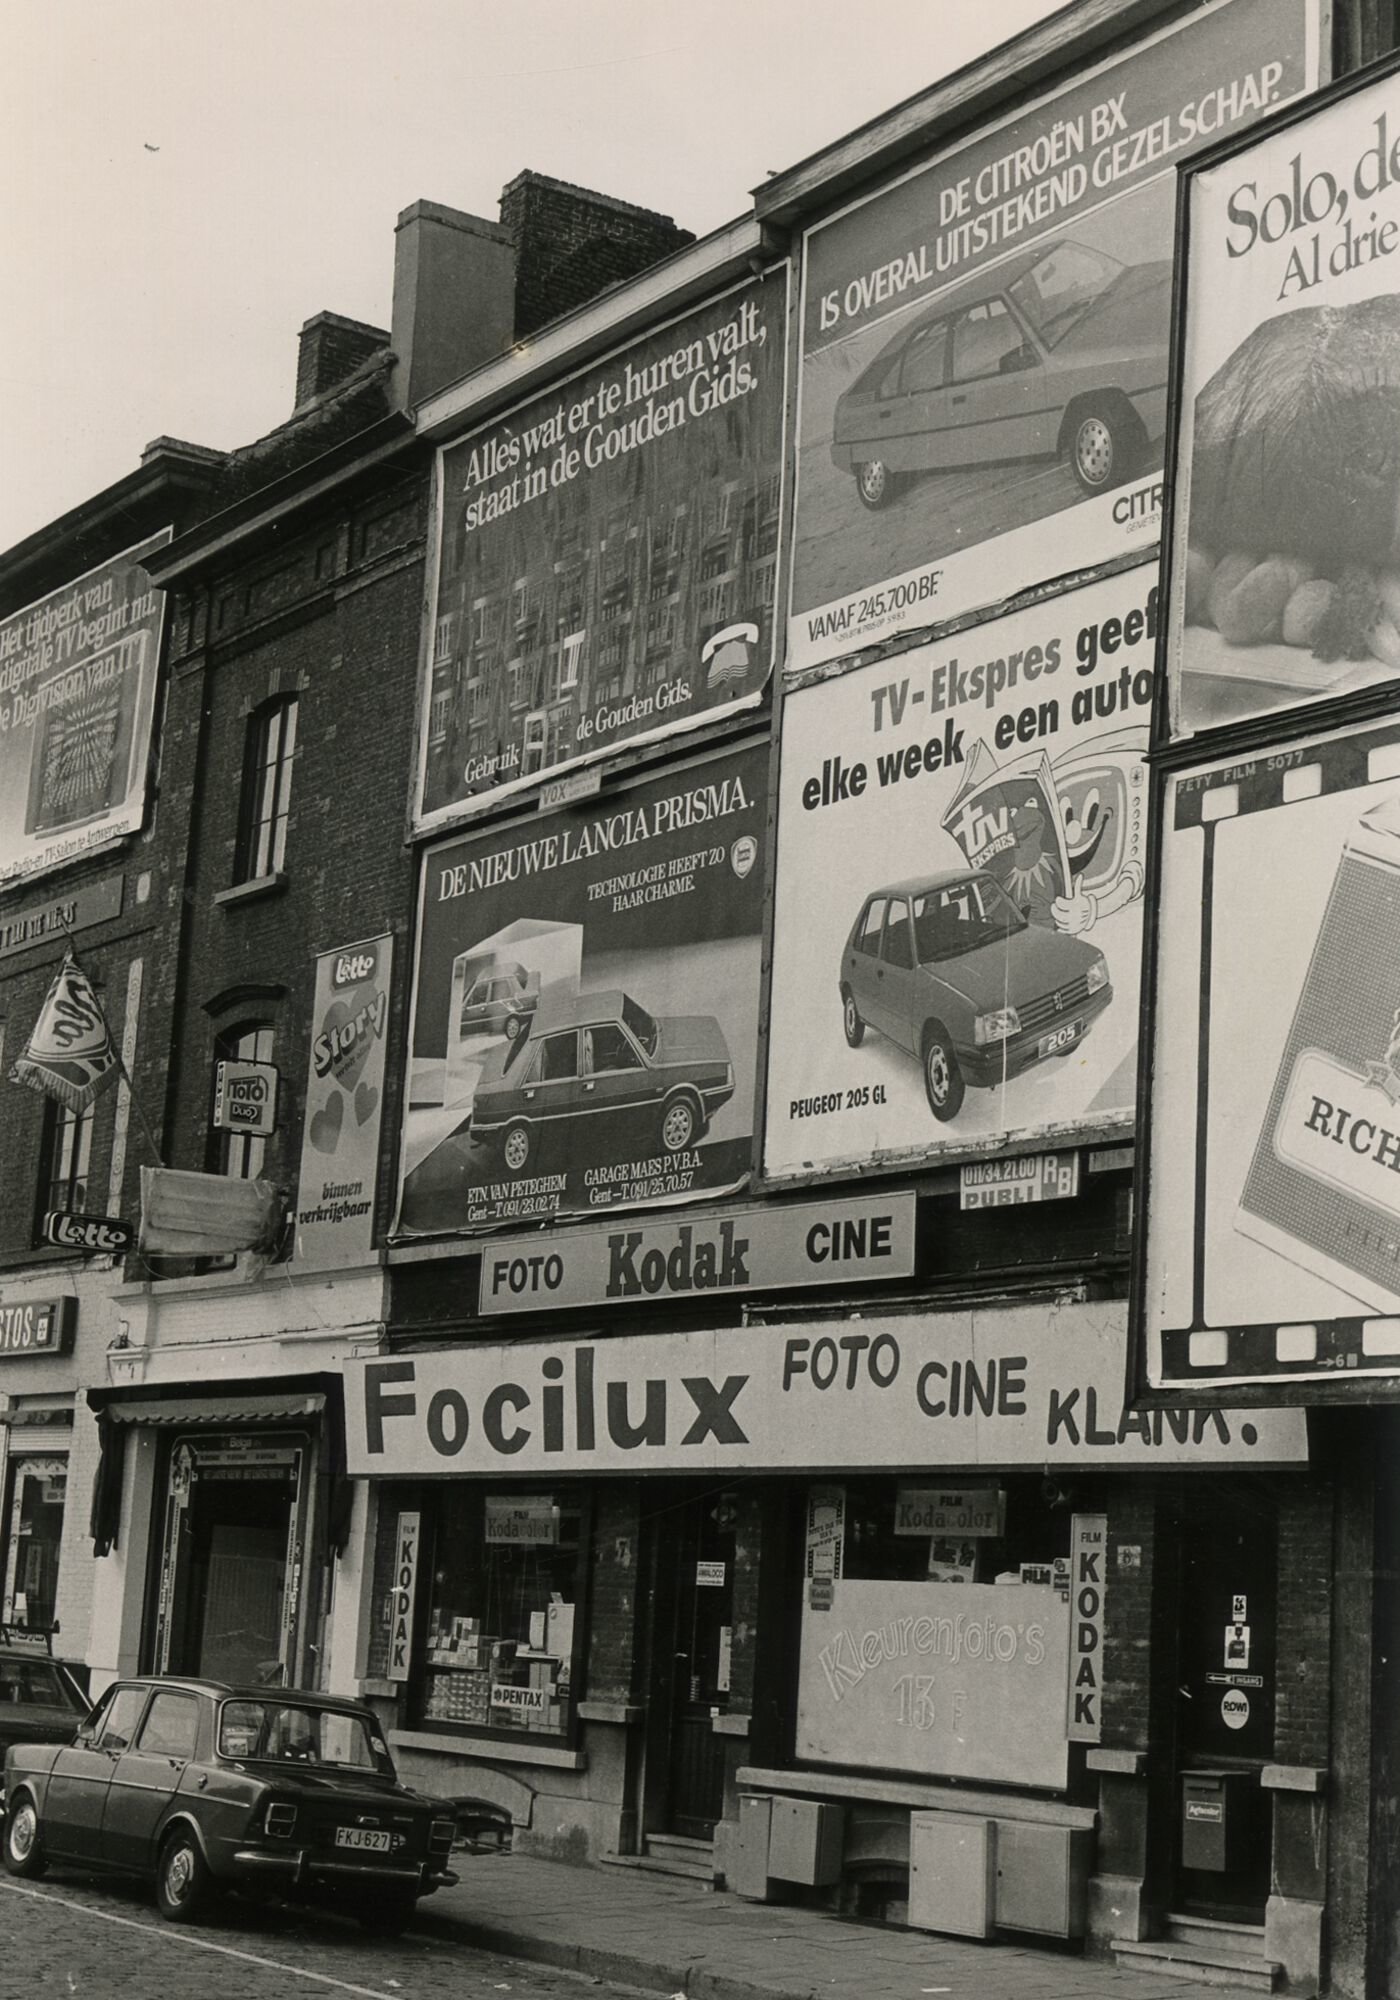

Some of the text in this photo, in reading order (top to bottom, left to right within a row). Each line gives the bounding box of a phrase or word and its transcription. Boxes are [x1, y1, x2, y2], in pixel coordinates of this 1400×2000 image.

[939, 92, 1128, 227] DE CITROËN BX
[1226, 152, 1348, 258] Solo,
[819, 290, 840, 330] IS
[843, 256, 933, 318] OVERAL
[936, 164, 1087, 272] UITSTEKEND
[1276, 211, 1399, 302] Al drie
[522, 404, 565, 458] wat
[568, 395, 595, 434] er
[598, 381, 621, 419] te
[624, 340, 705, 407] huren
[706, 301, 767, 361] valt,
[465, 356, 758, 532] staat in de Gouden Gids.
[0, 579, 113, 660] Het tijdperk van
[0, 591, 156, 693] digitale TV begint nu.
[808, 603, 856, 641] VANAF
[87, 654, 115, 687] van
[465, 678, 693, 784] Gebruik de Gouden Gids.
[802, 665, 1154, 811] elke week een auto
[542, 782, 567, 806] VOX
[1223, 762, 1256, 782] FILM
[438, 864, 467, 902] DE
[469, 839, 558, 894] NIEUWE
[559, 808, 651, 865] LANCIA
[651, 776, 756, 837] PRISMA.
[587, 863, 666, 901] TECHNOLOGIE
[669, 851, 708, 880] HEEFT
[705, 846, 725, 866] ZO
[613, 875, 695, 913] HAAR CHARME.
[335, 954, 374, 983] Lotto
[313, 991, 387, 1079] Story
[1047, 1023, 1076, 1051] 205
[789, 1085, 887, 1119] PEUGEOT 205 GL
[322, 1180, 362, 1200] binnen
[490, 1183, 509, 1200] VAN
[511, 1174, 567, 1197] PETEGHEM
[584, 1150, 703, 1186] GARAGE MAES P.V.B.A.
[964, 1156, 1037, 1187] 011/34.21.00
[299, 1200, 373, 1226] verkrijgbaar
[468, 1206, 487, 1222] Gent
[589, 1187, 611, 1204] Gent
[57, 1216, 127, 1250] Lotto
[492, 1216, 892, 1297] FOTO Kodak CINE
[782, 1333, 900, 1392] FOTO
[916, 1357, 1028, 1417] CINE
[364, 1346, 750, 1457] Focilux
[899, 1504, 993, 1530] Kodacolor
[940, 1495, 963, 1507] FILM
[1081, 1531, 1101, 1544] FILM
[393, 1540, 413, 1669] KODAK
[818, 1613, 1046, 1701] Kleurenfoto's
[1074, 1551, 1101, 1726] KODAK
[502, 1688, 542, 1708] PENTAX
[891, 1674, 936, 1731] 13
